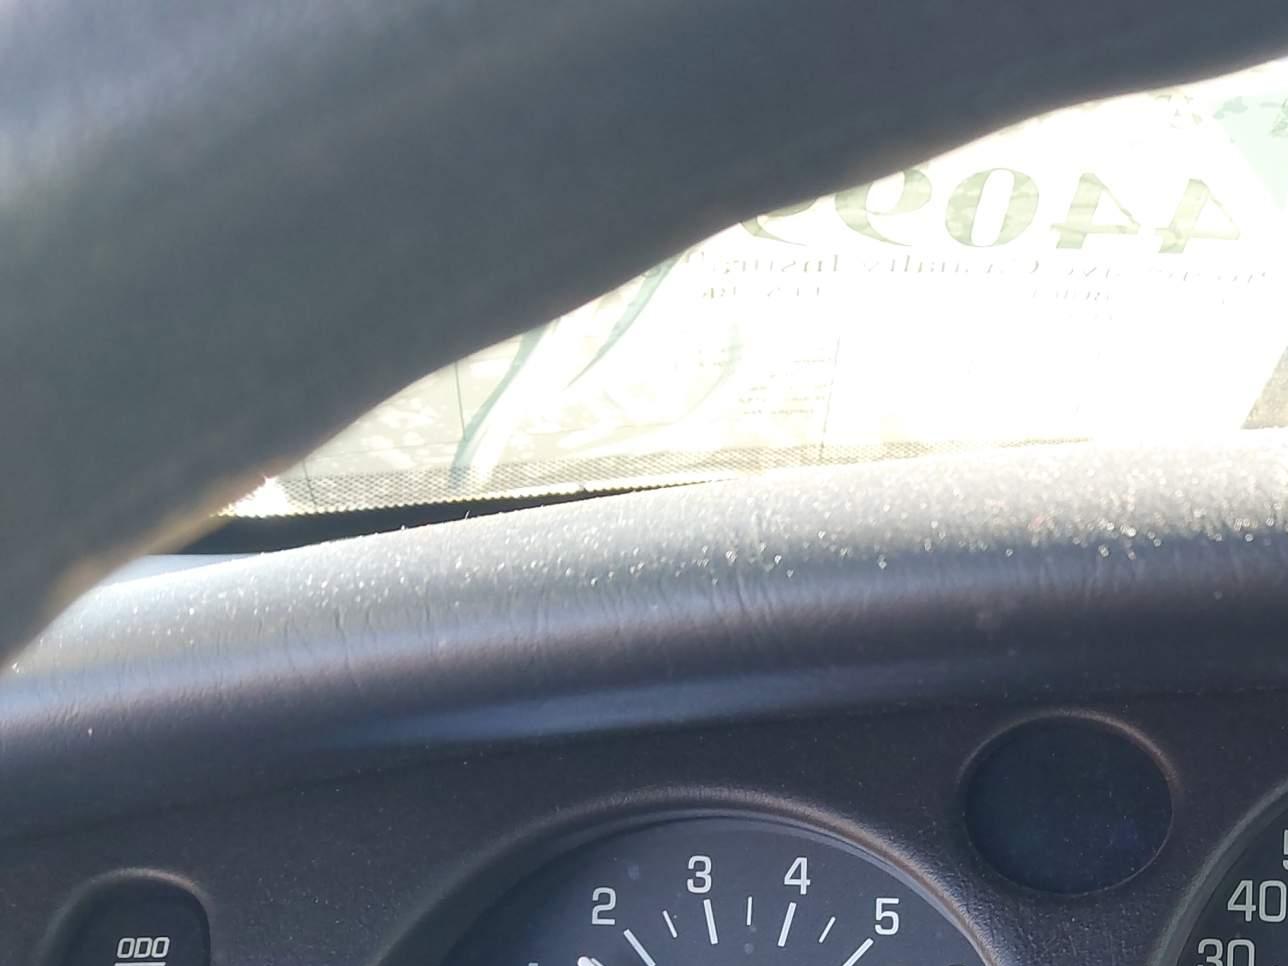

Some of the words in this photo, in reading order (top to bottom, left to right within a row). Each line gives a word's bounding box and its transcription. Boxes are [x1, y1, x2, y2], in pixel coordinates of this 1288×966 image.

[687, 856, 711, 893] 3
[784, 858, 810, 894] 4
[592, 888, 616, 925] 2
[875, 898, 899, 935] 5
[1228, 880, 1286, 922] 40
[117, 937, 169, 958] ODO
